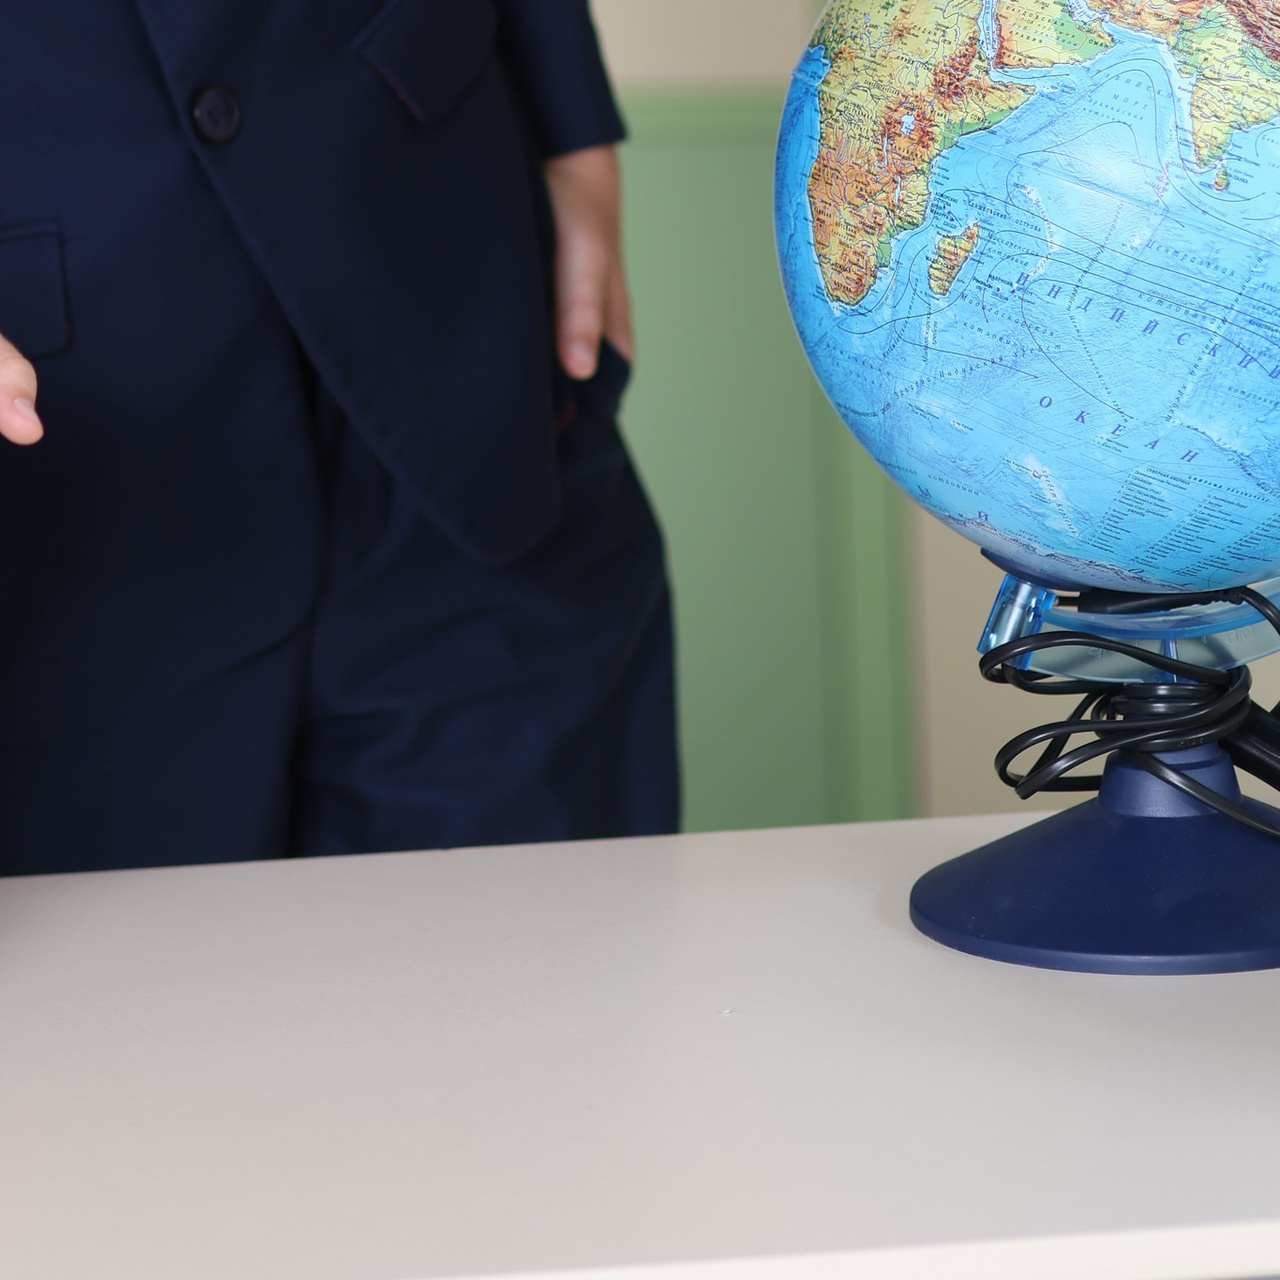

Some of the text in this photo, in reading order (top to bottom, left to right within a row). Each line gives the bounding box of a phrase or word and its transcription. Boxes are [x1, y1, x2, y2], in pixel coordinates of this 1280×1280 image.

[1112, 92, 1149, 111] МОРЕ
[1145, 238, 1236, 278] Центральная
[960, 292, 1055, 337] Мадагаскарская
[1038, 396, 1200, 463] ОКЕАН
